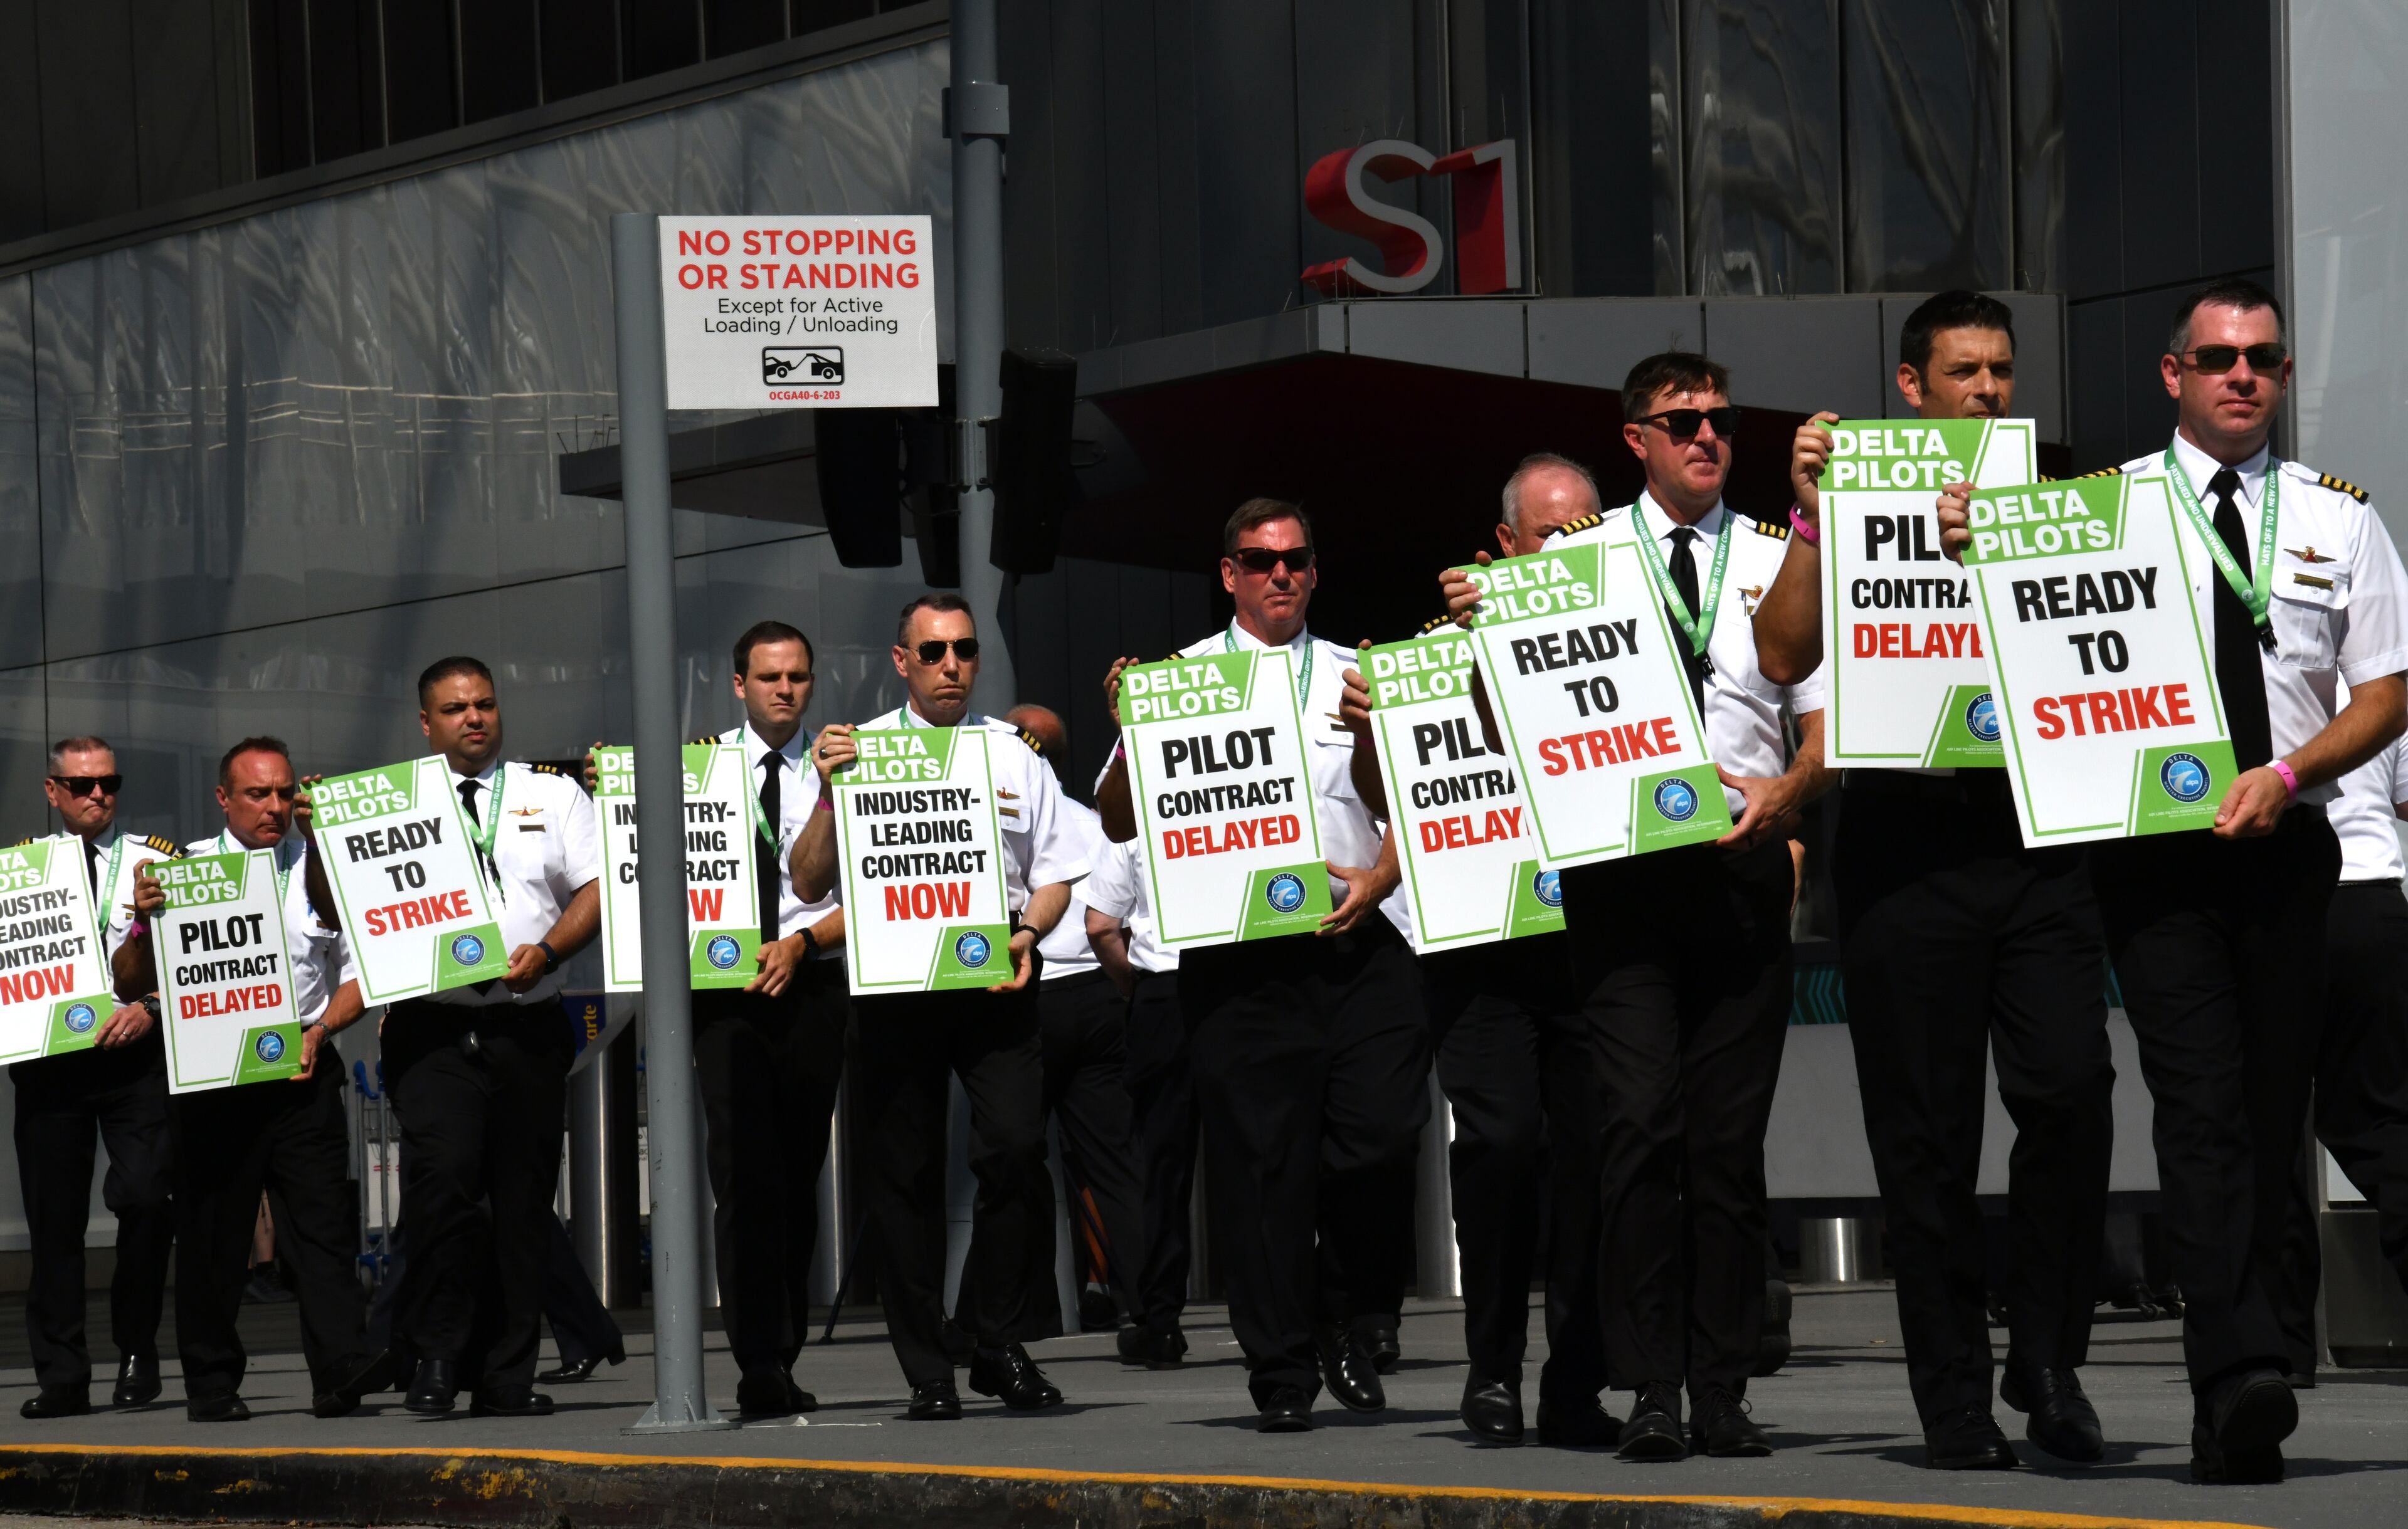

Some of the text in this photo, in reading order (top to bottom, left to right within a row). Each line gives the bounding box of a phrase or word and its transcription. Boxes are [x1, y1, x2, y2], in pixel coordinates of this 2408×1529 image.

[1301, 139, 1522, 295] S1
[679, 229, 917, 256] NO STOPPING
[678, 262, 919, 290] OR STANDING
[718, 297, 884, 316] Except for Active
[704, 317, 781, 335] Loading
[803, 316, 898, 335] Unloading
[769, 390, 841, 401] OCGA40-6-203
[1832, 429, 1948, 456] DELTA
[1834, 460, 1965, 488] PILOTS
[1968, 490, 2090, 527] DELTA
[2267, 488, 2276, 508] NEW
[2170, 463, 2235, 572] FATIGUED AND UNDERVALUED
[2266, 515, 2274, 526] TO
[1717, 543, 1726, 560] NEW
[1864, 515, 1951, 561] PIL
[1974, 520, 2111, 560] PILOTS
[2264, 528, 2273, 544] OFF
[1634, 511, 1680, 606] FATIGUED AND UNDERVALUED
[2261, 541, 2272, 566] HATS
[1466, 558, 1573, 595] DELTA
[1710, 577, 1719, 591] OFF
[1714, 567, 1722, 576] TO
[1476, 582, 1594, 624] PILOTS
[1705, 591, 1716, 612] HATS
[2012, 567, 2157, 622] READY
[1371, 639, 1475, 678] DELTA
[1511, 619, 1639, 675] READY
[2068, 630, 2129, 675] TO
[1127, 663, 1225, 696] DELTA
[1377, 666, 1472, 707] PILOT
[1564, 676, 1619, 717] TO
[1131, 686, 1240, 722] PILOTS
[2034, 683, 2195, 740] STRIKE
[855, 735, 928, 758] ELTA
[1161, 727, 1275, 779] PILOT
[1412, 717, 1491, 766] PIL
[1538, 717, 1681, 776] STRIKE
[842, 758, 941, 783] PILOTS
[2168, 755, 2194, 764] DELTA
[312, 773, 394, 805] DELTA
[494, 792, 500, 800] TO
[1157, 777, 1295, 819] CONTRACT
[1411, 767, 1516, 809] CONTR
[1660, 780, 1682, 788] DELTA
[2164, 781, 2177, 797] MASTER
[2200, 777, 2209, 794] COUNCIL
[319, 791, 409, 826] PILOTS
[855, 788, 981, 816] INDUSTRY-
[1657, 804, 1670, 819] MASTER
[345, 817, 442, 863] READY
[870, 819, 973, 847] LEADING
[1163, 814, 1301, 859] DELAYED
[1419, 806, 1528, 853] DELAY
[154, 861, 226, 886] DELTA
[384, 861, 426, 891] TO
[862, 850, 986, 879] CONTRACT
[365, 889, 473, 936] STRIKE
[884, 881, 971, 922] NOW
[0, 913, 73, 944] EADING
[179, 913, 264, 954] PILOT
[0, 964, 74, 1006] NOW
[176, 953, 278, 986] CONTRACT
[179, 983, 282, 1019] DELAYED
[583, 1004, 598, 1043] arte
